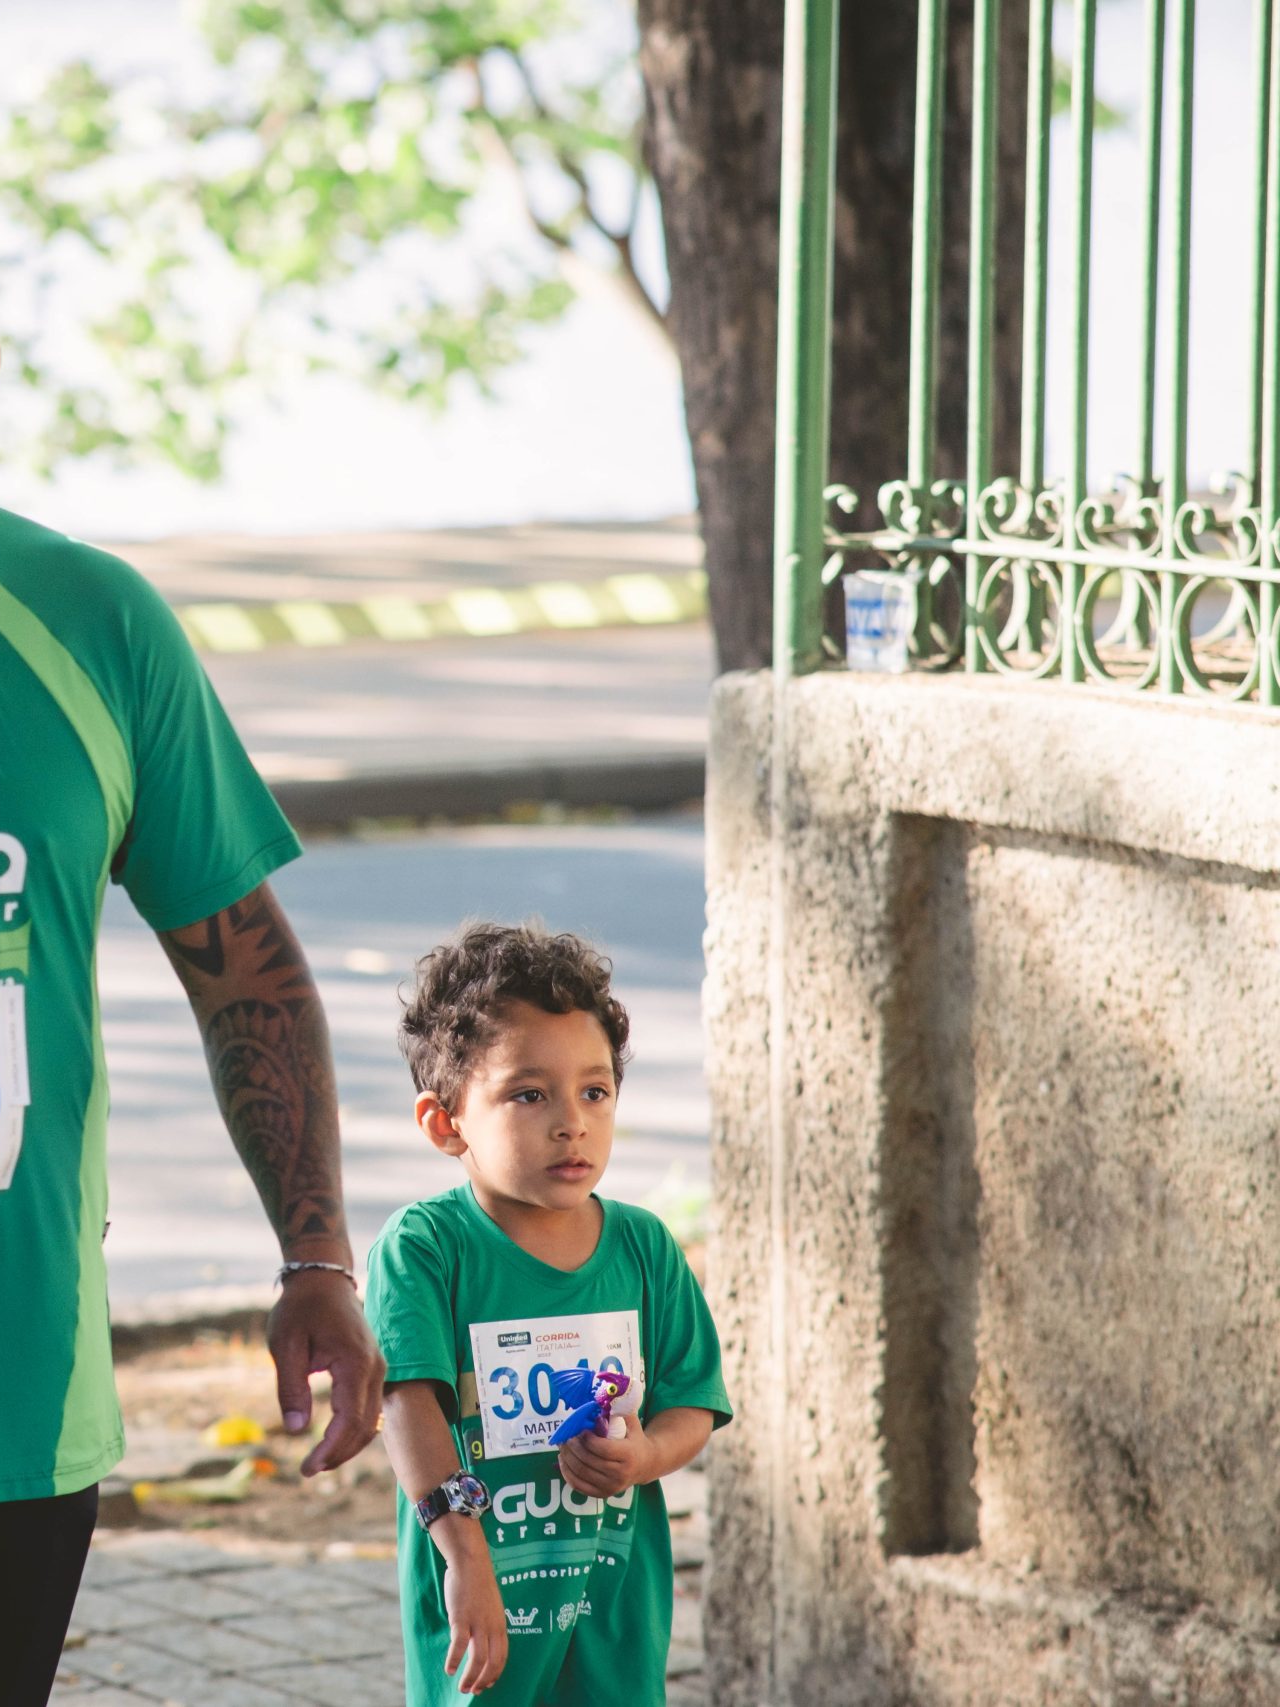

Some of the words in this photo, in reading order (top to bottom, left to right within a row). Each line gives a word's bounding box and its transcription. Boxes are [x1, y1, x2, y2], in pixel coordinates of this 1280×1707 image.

[500, 1333, 528, 1343] Unimed
[535, 1332, 580, 1343] CORRIDA
[501, 1566, 580, 1585] assessoria
